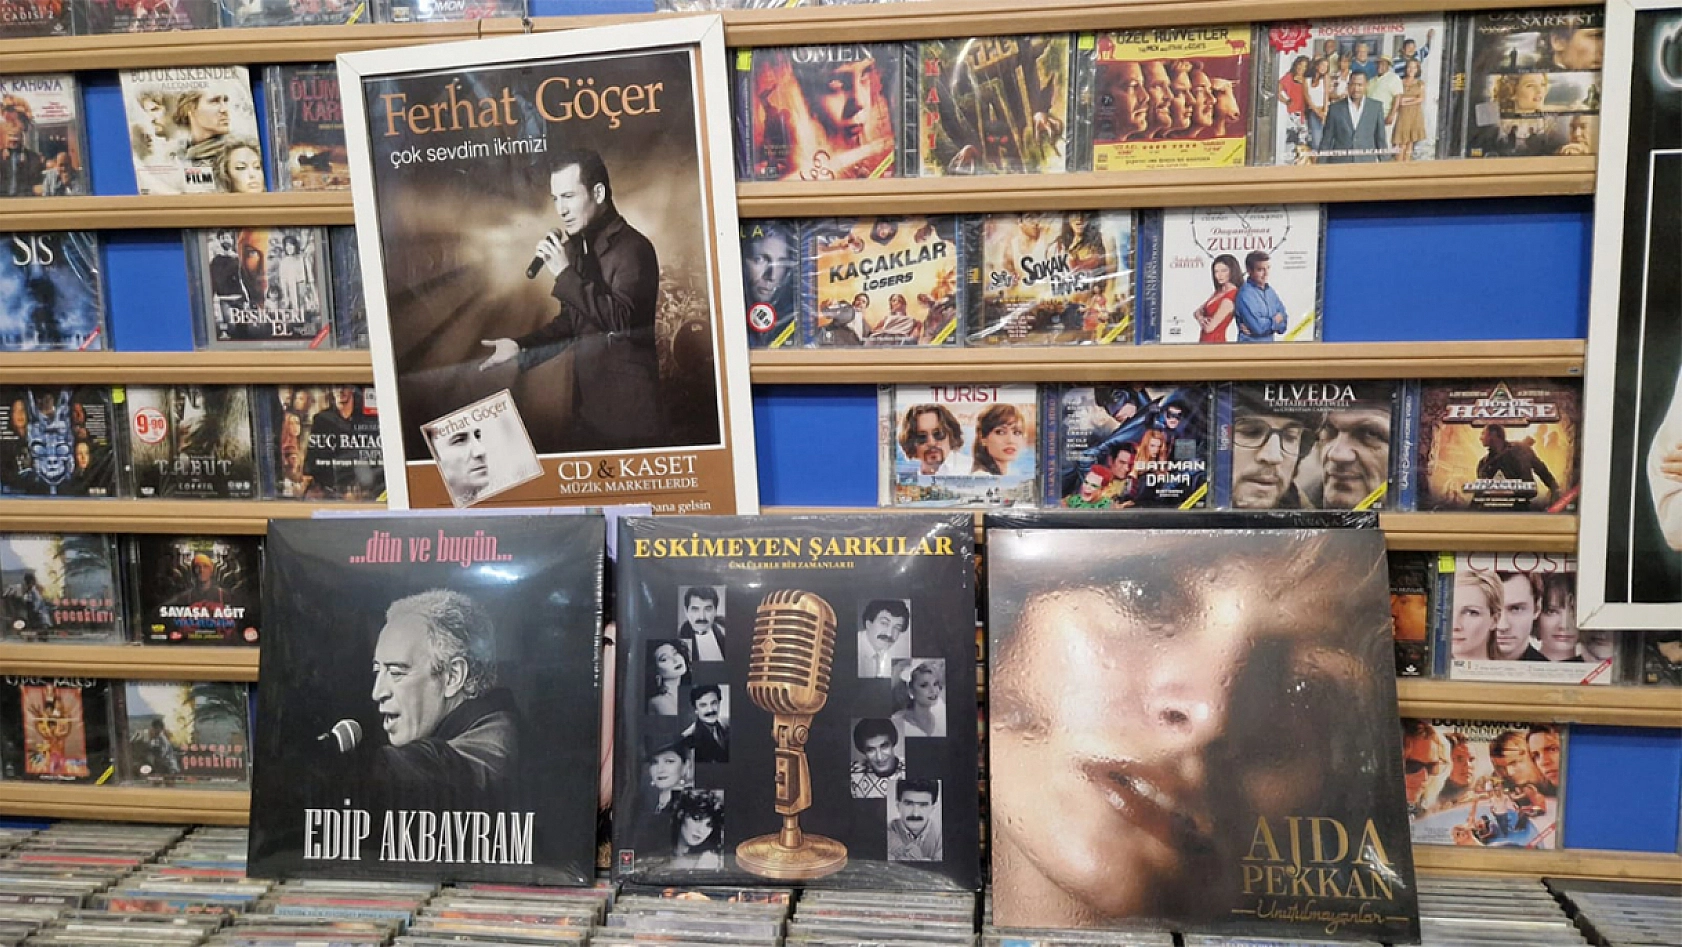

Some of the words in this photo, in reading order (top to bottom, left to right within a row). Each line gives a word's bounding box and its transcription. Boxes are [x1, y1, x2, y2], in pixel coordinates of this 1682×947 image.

[380, 82, 518, 137] Ferhat
[535, 77, 664, 129] Göçer
[390, 145, 423, 169] çok
[426, 139, 490, 161] sevdim
[493, 134, 548, 157] ikimizi
[829, 241, 947, 283] KAÇAKLAR
[863, 271, 914, 292] LOSERS
[1264, 383, 1356, 401] ELVEDA
[309, 434, 337, 450] SUÇ
[155, 459, 231, 476] TABUT
[558, 460, 592, 481] CD
[597, 459, 615, 480] &
[618, 455, 698, 478] KASET
[559, 480, 602, 495] MÜZİK
[604, 477, 699, 492] MARKETLERDE
[678, 500, 711, 514] gelsin
[408, 537, 431, 562] ve
[633, 533, 802, 558] ESKİMEYEN
[809, 536, 955, 562] ŞARKILAR
[1467, 551, 1577, 574] CLOSE
[160, 606, 210, 620] SAVAŞA
[303, 798, 370, 861] EDİP
[379, 809, 535, 865] AKBAYRAM
[1241, 815, 1395, 877] AJDA
[1241, 864, 1393, 900] PEKKAN
